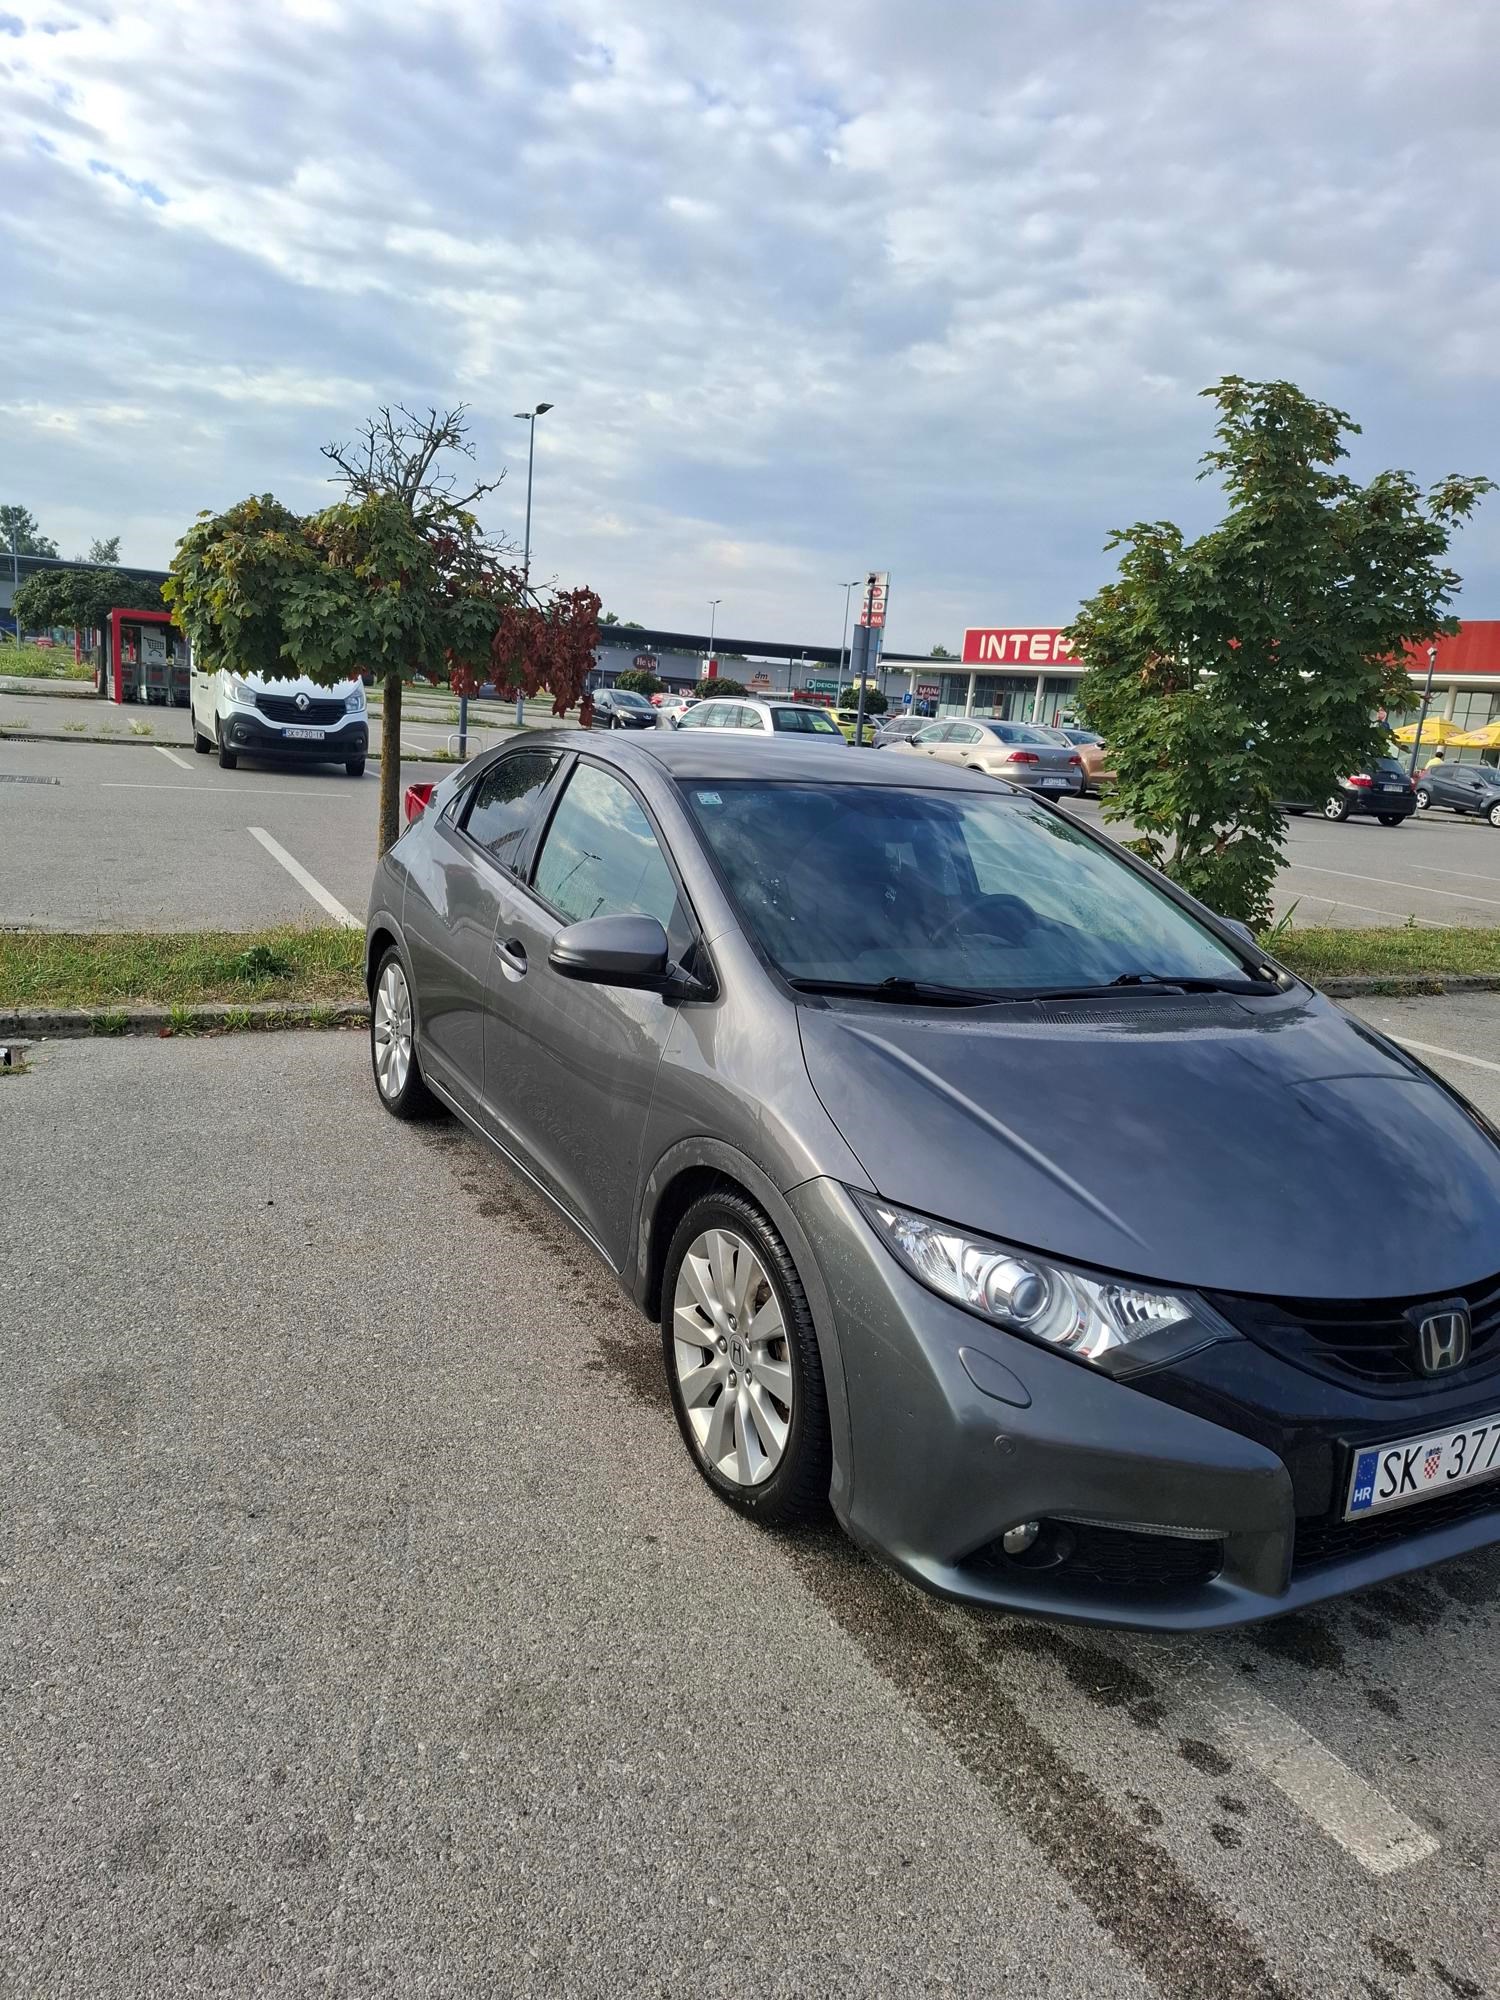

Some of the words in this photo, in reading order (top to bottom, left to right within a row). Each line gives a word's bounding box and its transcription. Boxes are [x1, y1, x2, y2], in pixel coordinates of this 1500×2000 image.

[861, 616, 882, 624] MNA
[1379, 1446, 1423, 1498] SK
[1353, 1487, 1372, 1502] HR
